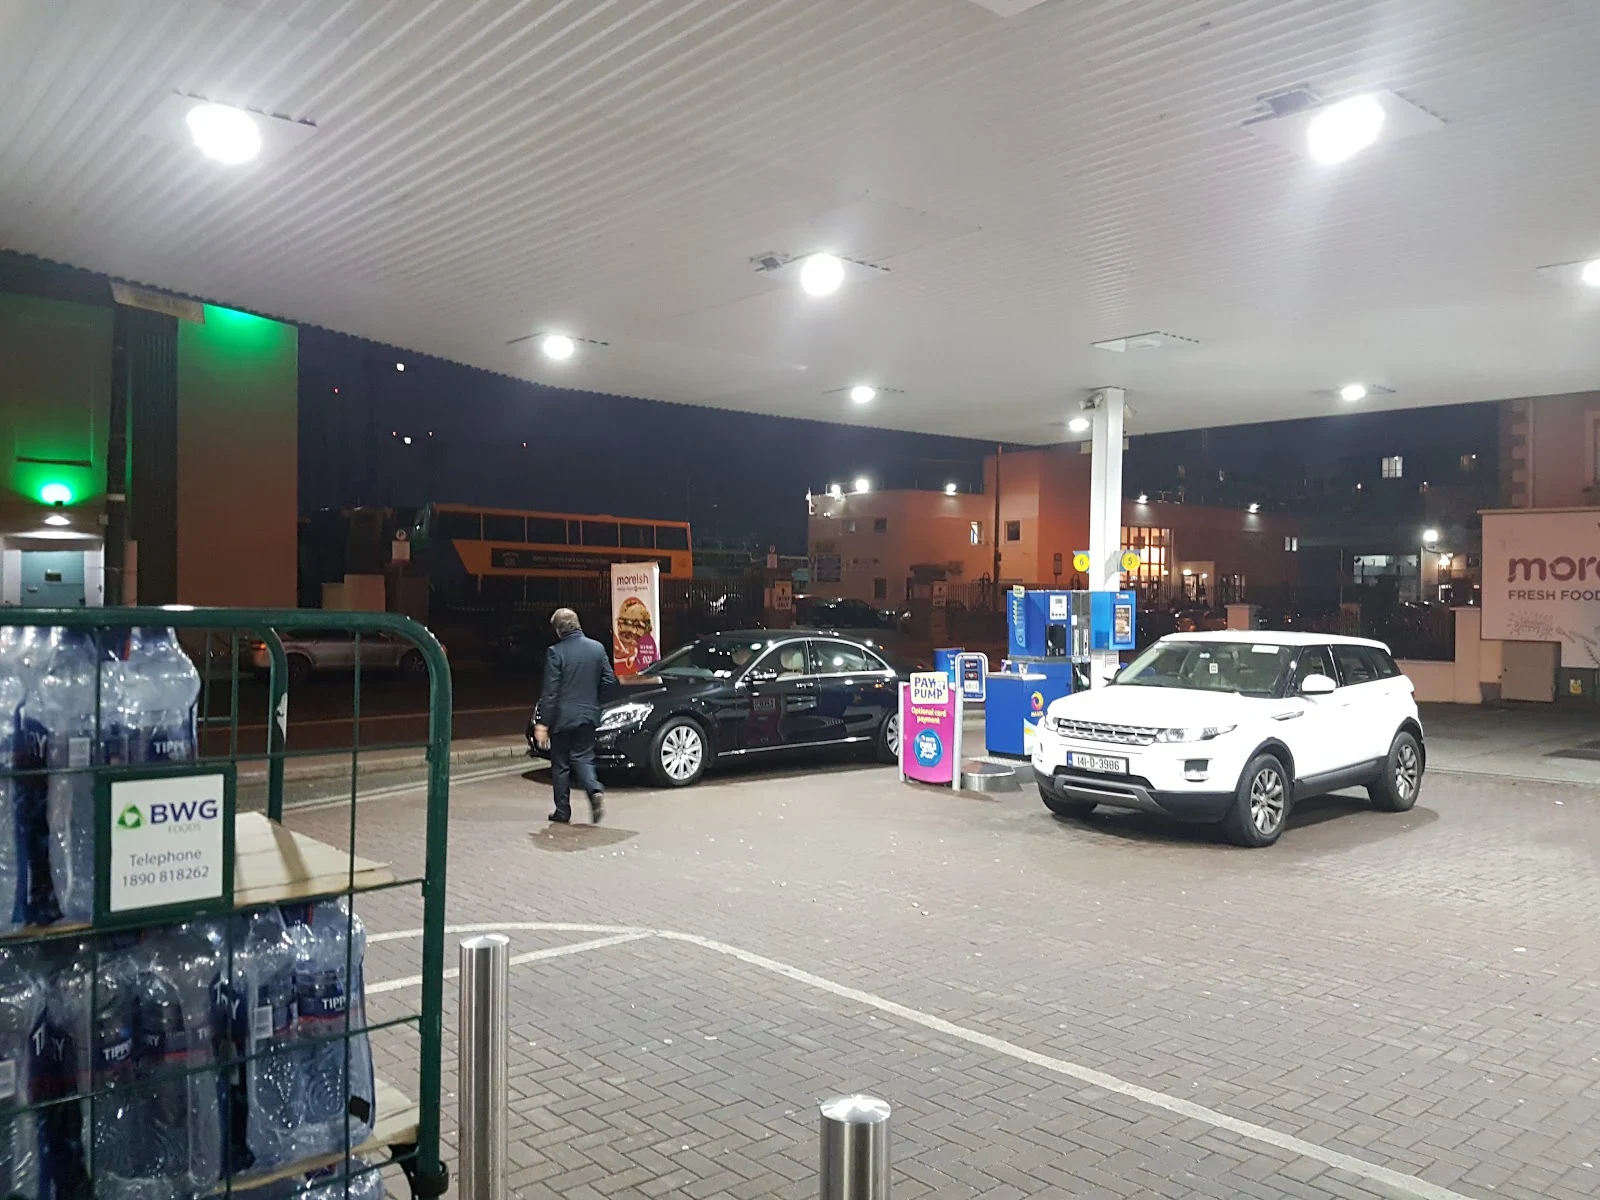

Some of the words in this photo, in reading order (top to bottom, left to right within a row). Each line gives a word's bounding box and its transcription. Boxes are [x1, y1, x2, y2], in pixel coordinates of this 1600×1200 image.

[1507, 556, 1600, 583] mor
[1508, 589, 1556, 601] FRESH
[914, 676, 935, 688] PAY
[914, 688, 942, 700] PUMP
[911, 706, 933, 716] Optional
[934, 709, 947, 718] card
[917, 716, 940, 725] payment
[1077, 756, 1120, 771] 141-D-3986
[150, 799, 218, 825] BWG
[168, 823, 201, 834] FOODS
[130, 850, 202, 867] Telephone
[122, 872, 155, 888] 1890
[159, 866, 209, 883] 818262
